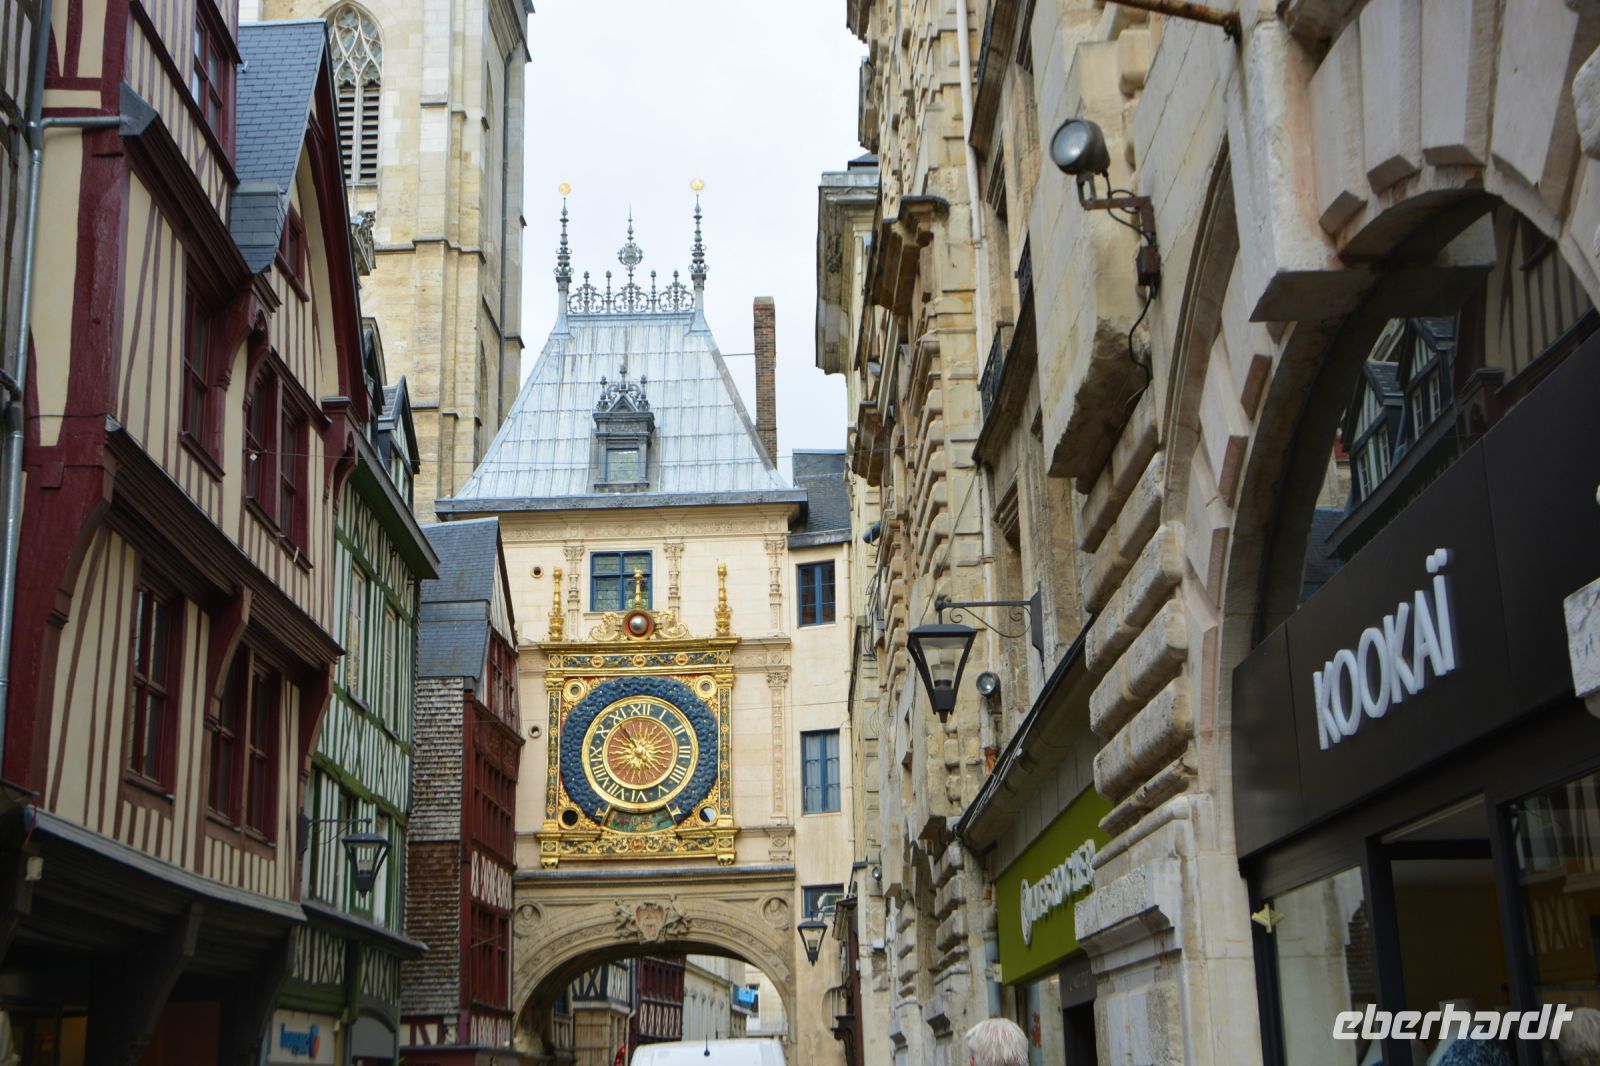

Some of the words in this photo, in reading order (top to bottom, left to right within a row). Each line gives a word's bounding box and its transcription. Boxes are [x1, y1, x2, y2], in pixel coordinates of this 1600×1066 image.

[608, 707, 627, 726] XI
[630, 703, 651, 716] XII
[595, 724, 611, 740] X
[672, 725, 686, 736] II
[590, 746, 603, 762] IX
[679, 745, 691, 758] III
[669, 764, 687, 784] IIII
